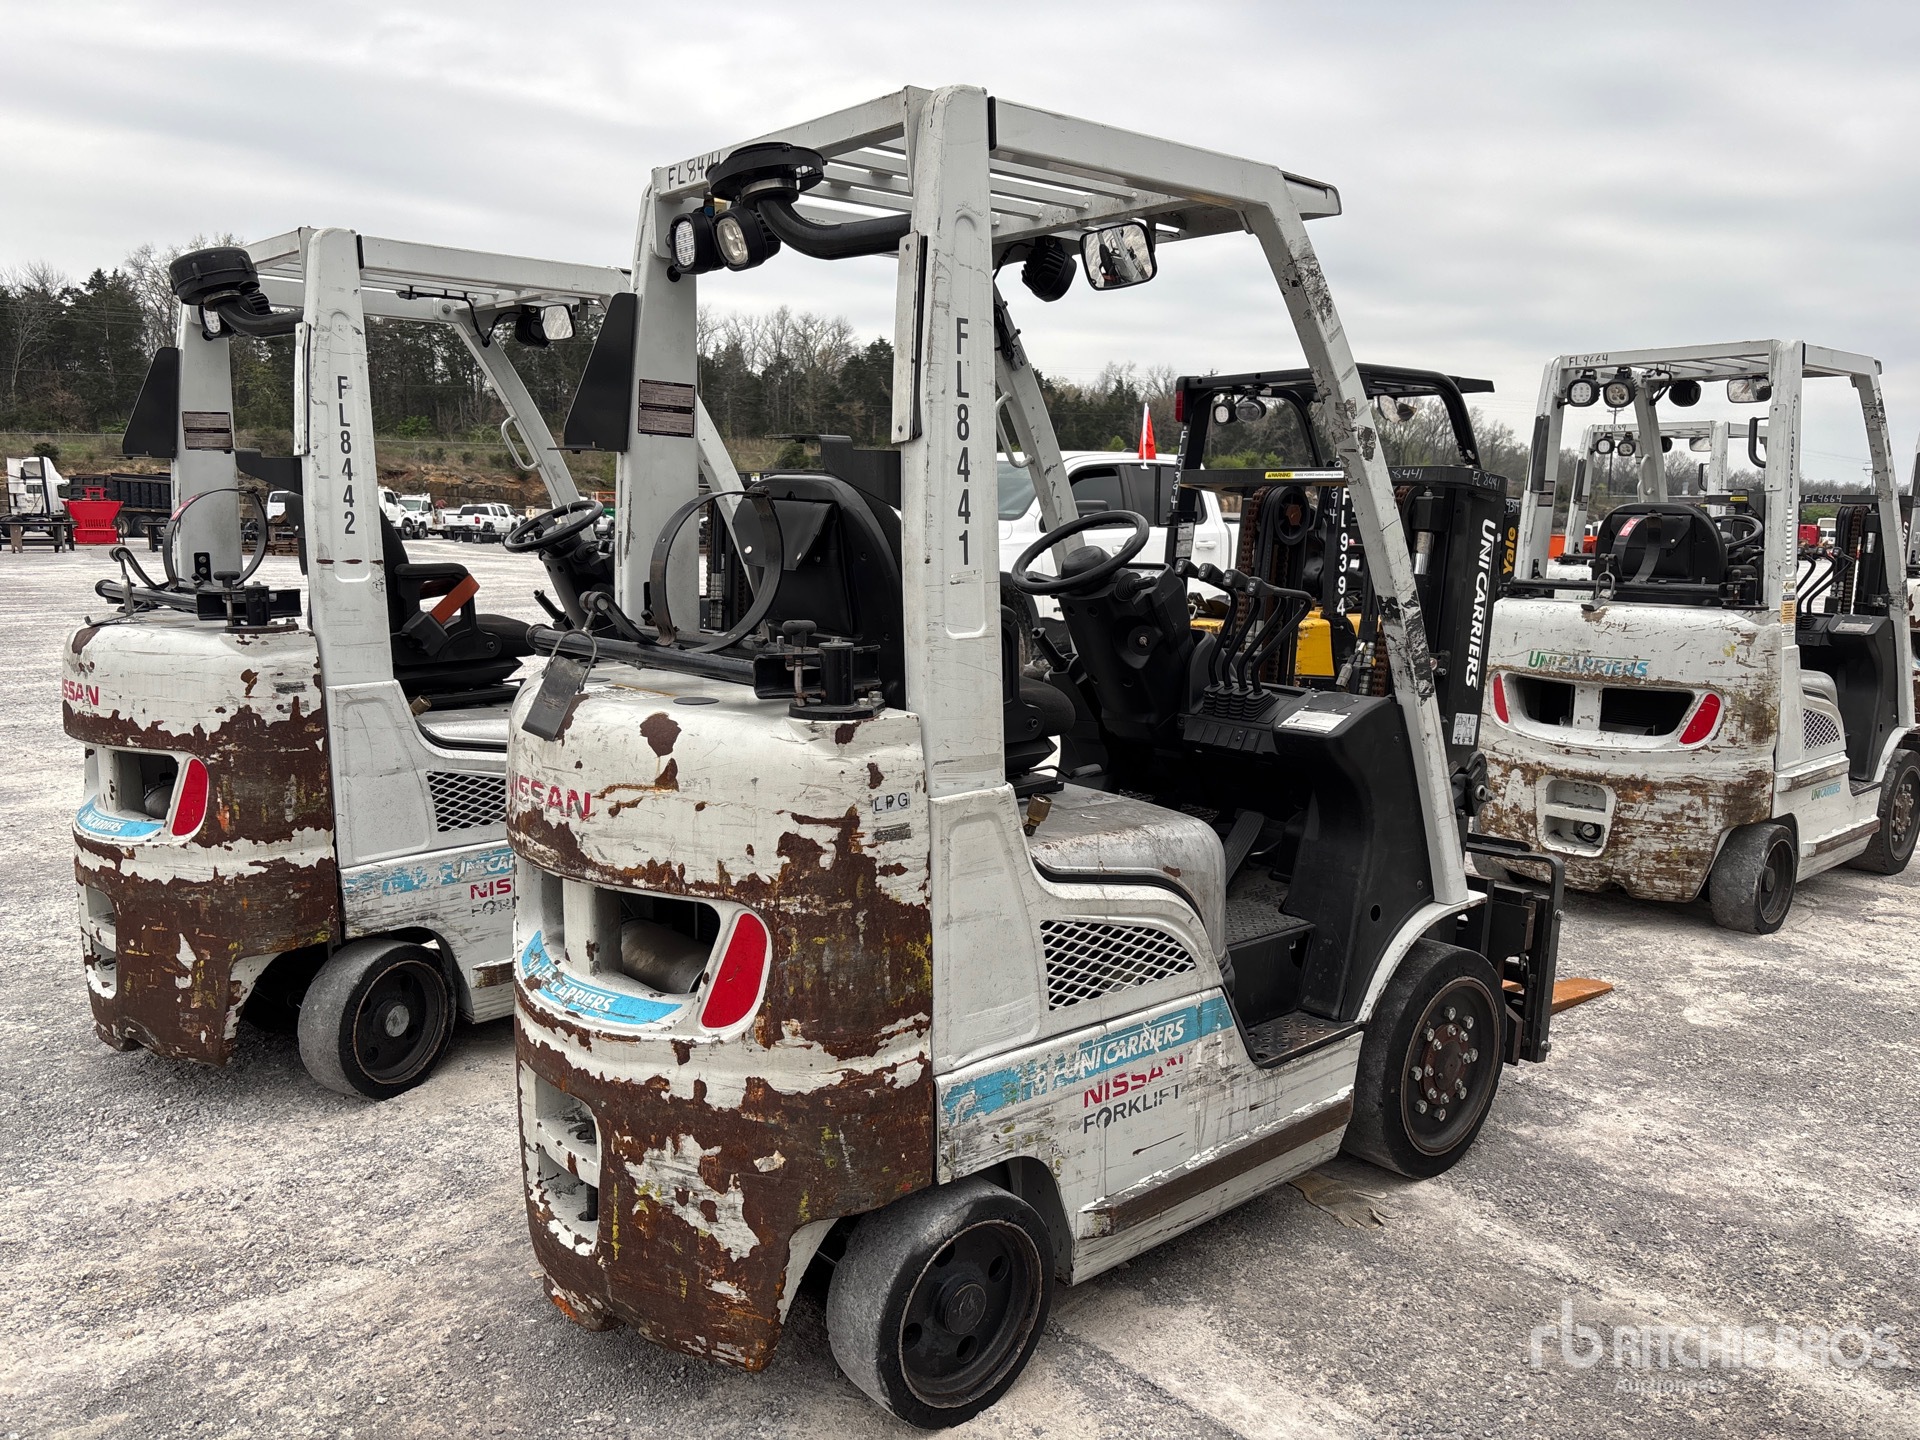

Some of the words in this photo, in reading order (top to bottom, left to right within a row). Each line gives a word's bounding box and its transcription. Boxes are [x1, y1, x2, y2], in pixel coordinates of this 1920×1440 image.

[337, 375, 356, 535] FL8442
[956, 317, 971, 566] FL8441
[1503, 526, 1516, 575] Yale
[1465, 518, 1498, 690] UNICARRIERS
[874, 792, 908, 812] LPG
[1083, 1083, 1183, 1134] FORKLIFT
